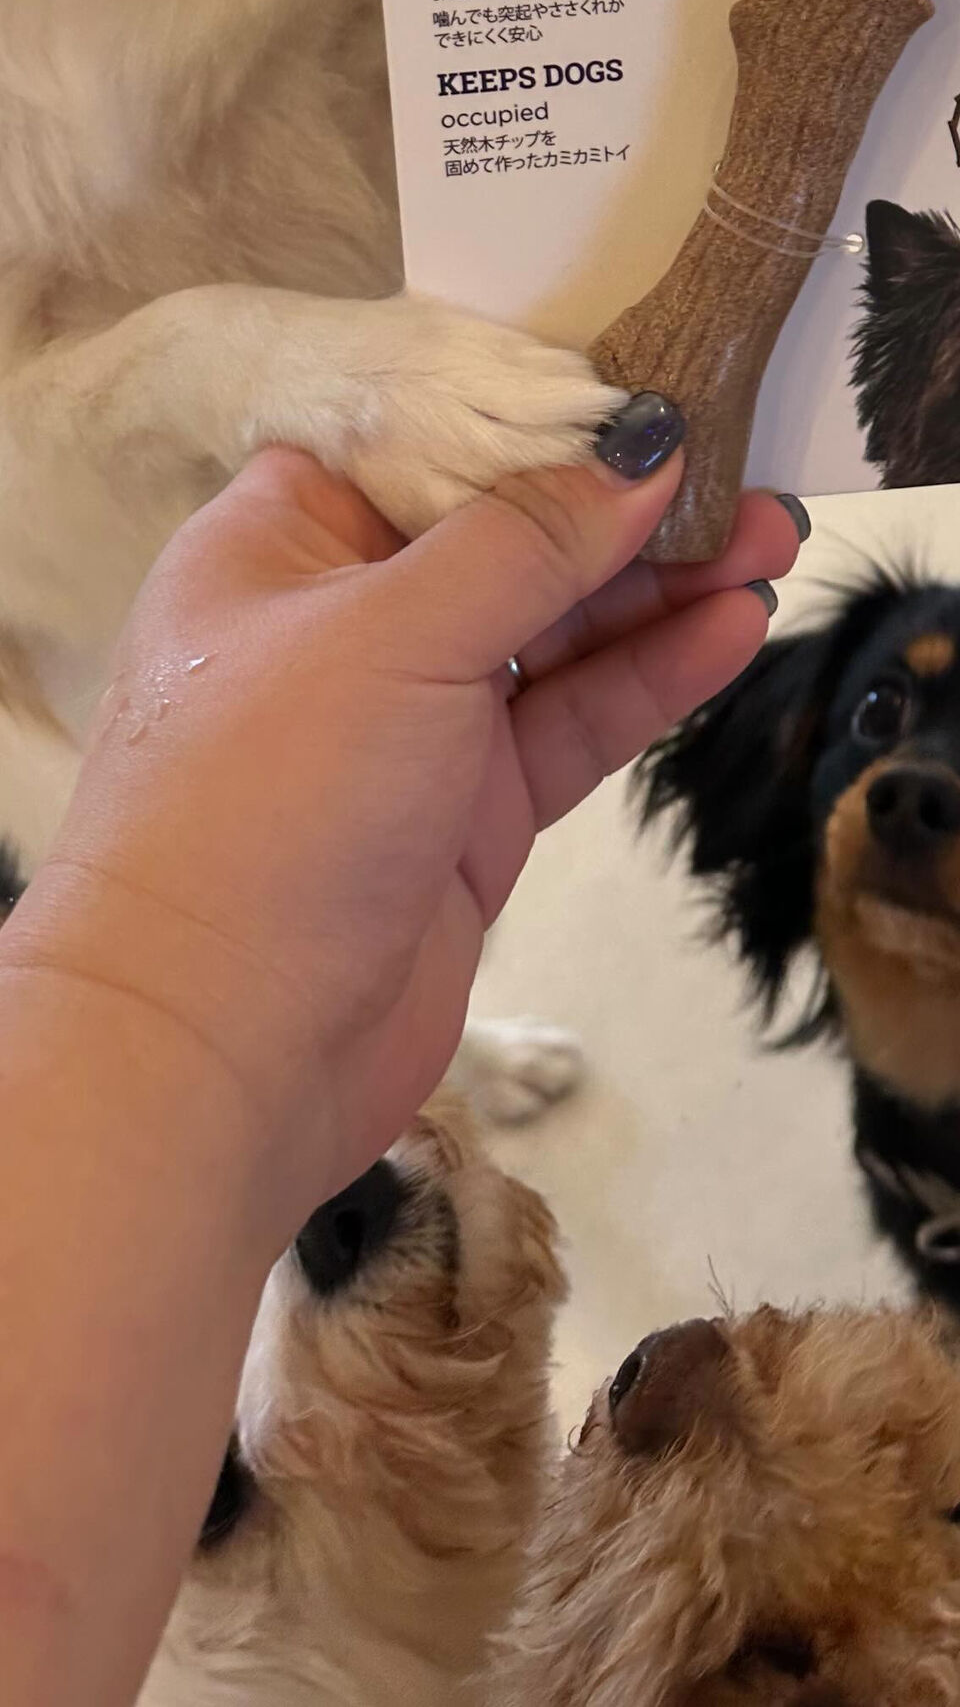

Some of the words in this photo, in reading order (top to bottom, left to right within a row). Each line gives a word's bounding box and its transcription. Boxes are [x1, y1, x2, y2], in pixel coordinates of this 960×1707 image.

[434, 25, 543, 49] できにくく安心
[437, 66, 537, 96] KEEPS
[543, 59, 624, 89] DOGS
[441, 101, 549, 129] occupied
[443, 130, 557, 156] 天然木チップを
[445, 144, 631, 177] 固めて作ったカミカミトイ
